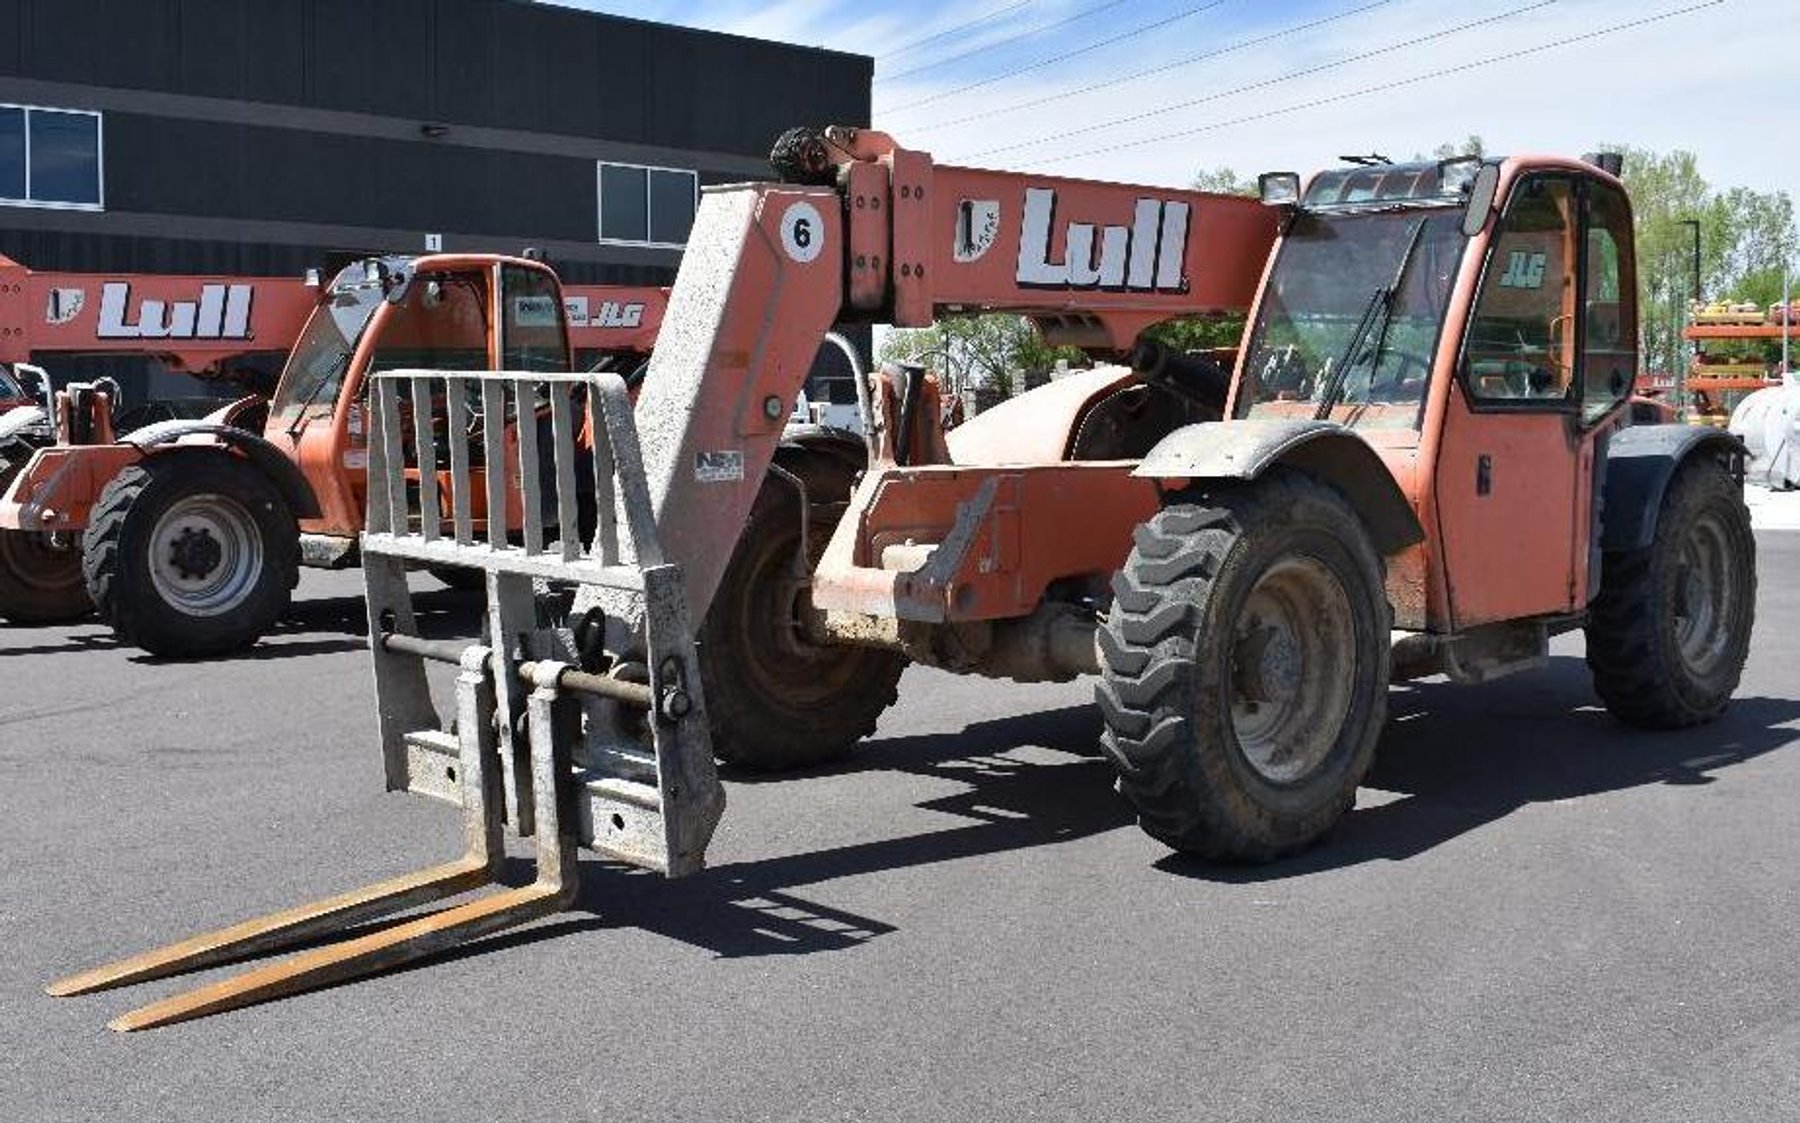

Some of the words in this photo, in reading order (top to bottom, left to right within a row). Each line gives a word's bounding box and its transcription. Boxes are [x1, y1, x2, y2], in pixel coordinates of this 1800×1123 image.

[794, 218, 811, 249] 6
[1016, 187, 1192, 295] Lull
[1499, 250, 1546, 289] JLG
[97, 281, 254, 341] Lull
[591, 301, 646, 328] JLG
